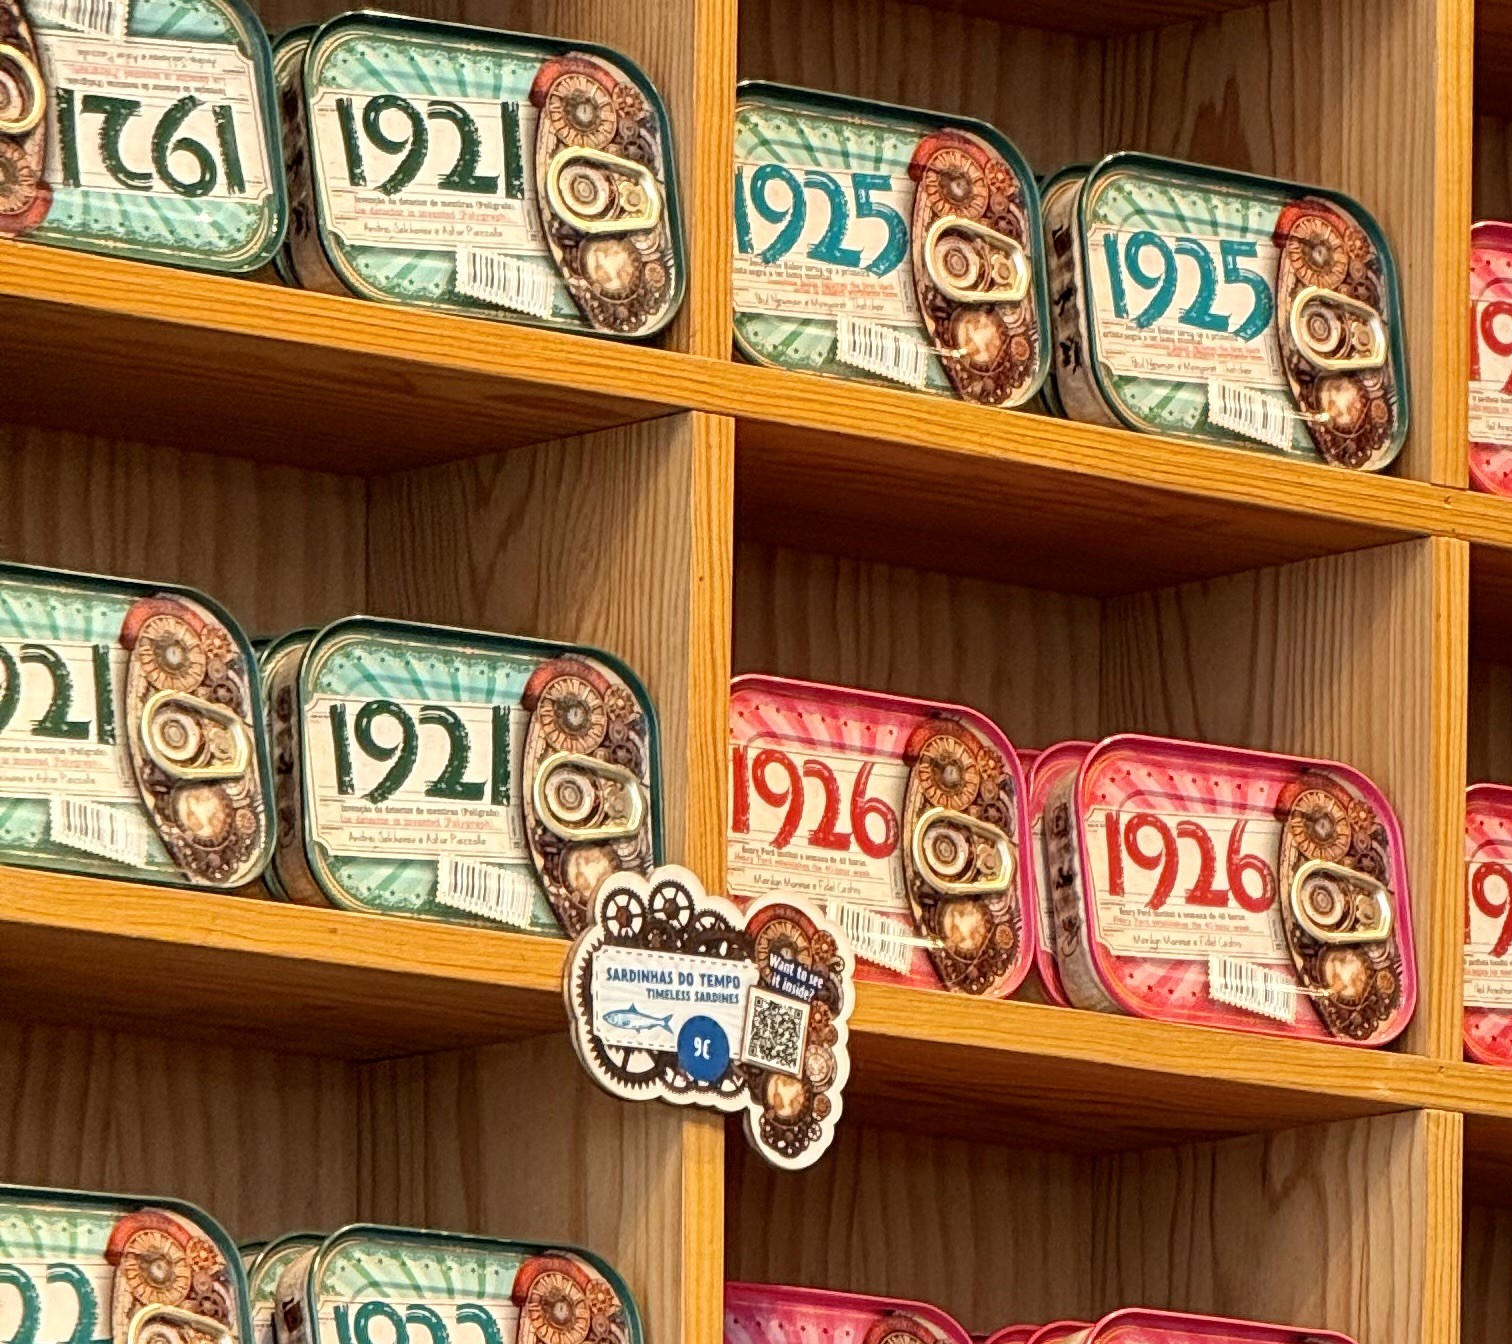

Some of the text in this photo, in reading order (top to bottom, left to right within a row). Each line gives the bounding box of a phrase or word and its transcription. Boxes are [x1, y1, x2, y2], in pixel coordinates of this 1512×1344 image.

[56, 87, 246, 199] 1921
[335, 93, 526, 200] 1921
[733, 161, 911, 280] 1925
[1102, 228, 1275, 343] 1925
[0, 643, 118, 748] 21
[328, 699, 512, 806] 1921
[730, 743, 900, 861] 1926
[1103, 809, 1279, 914] 1926
[606, 966, 741, 989] SARDINHAS DO TEMPO
[646, 988, 739, 1005] TIMELESS SARDINES
[769, 952, 824, 989] Want to see
[771, 973, 815, 1002] it inside?
